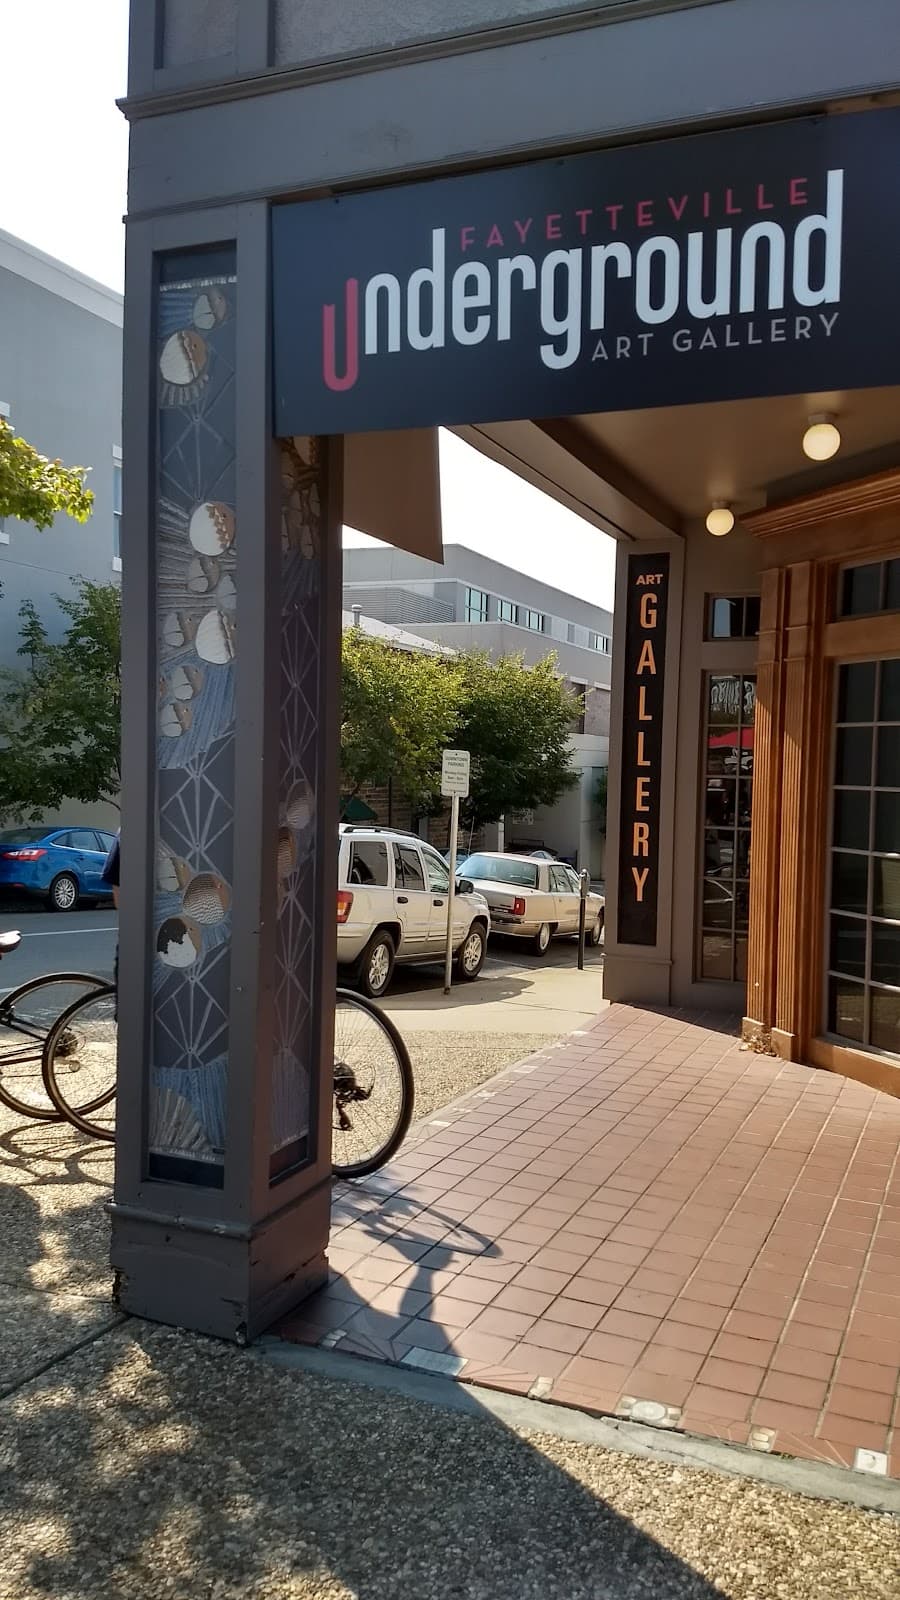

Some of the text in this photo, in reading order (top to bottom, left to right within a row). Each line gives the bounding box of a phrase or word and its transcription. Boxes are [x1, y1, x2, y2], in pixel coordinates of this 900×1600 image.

[461, 178, 808, 252] FAYETTEVILLE
[322, 169, 844, 392] Underground
[591, 312, 840, 362] ART GALLERY
[636, 574, 663, 586] ART
[632, 592, 657, 902] GALLERY
